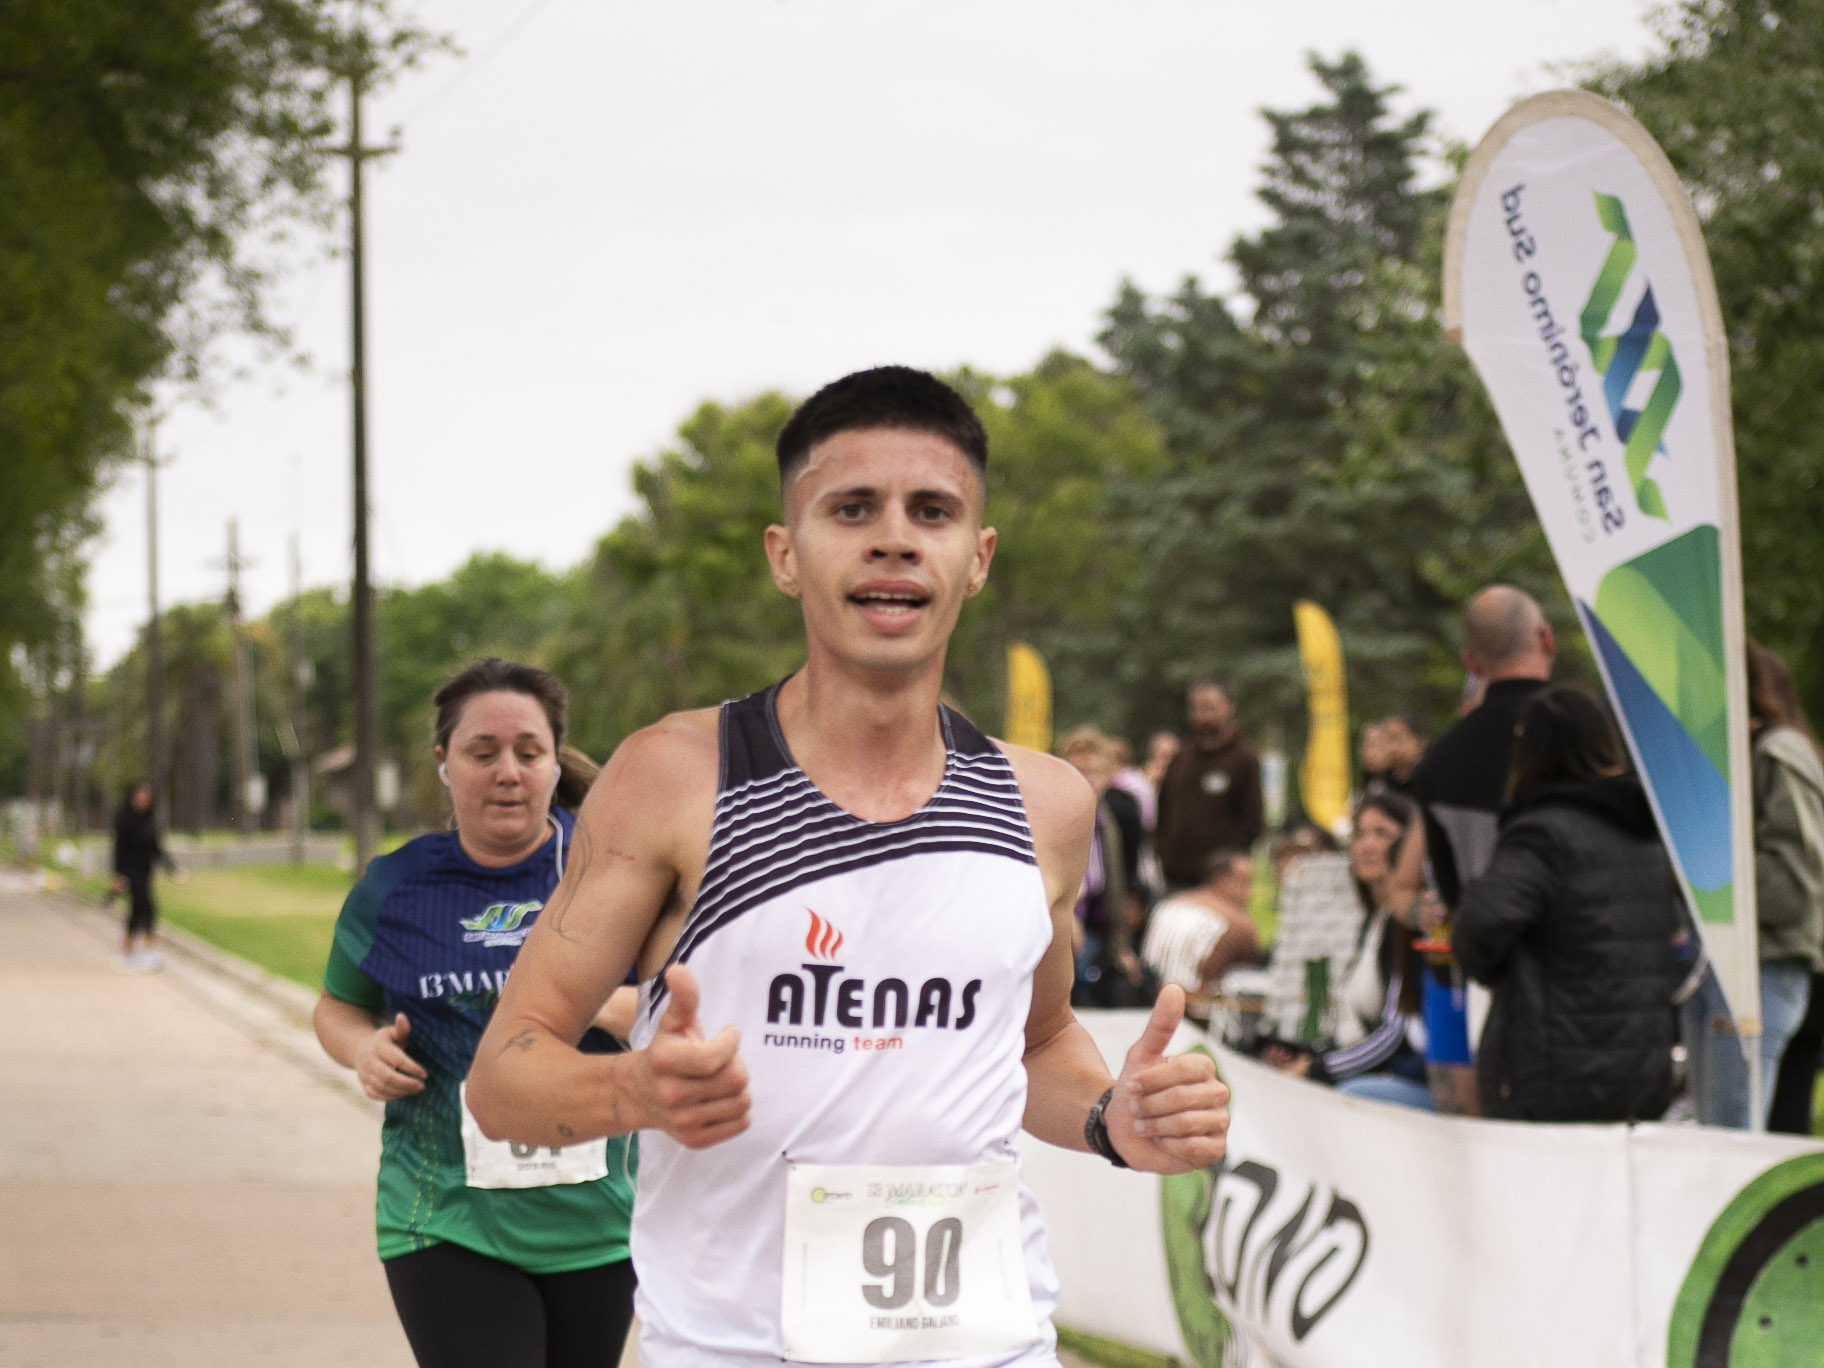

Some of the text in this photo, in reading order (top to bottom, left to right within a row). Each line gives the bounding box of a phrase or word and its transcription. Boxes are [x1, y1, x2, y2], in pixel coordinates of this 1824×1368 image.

[767, 963, 982, 1031] ATENAS
[764, 1032, 903, 1054] running team
[861, 1216, 963, 1310] 90
